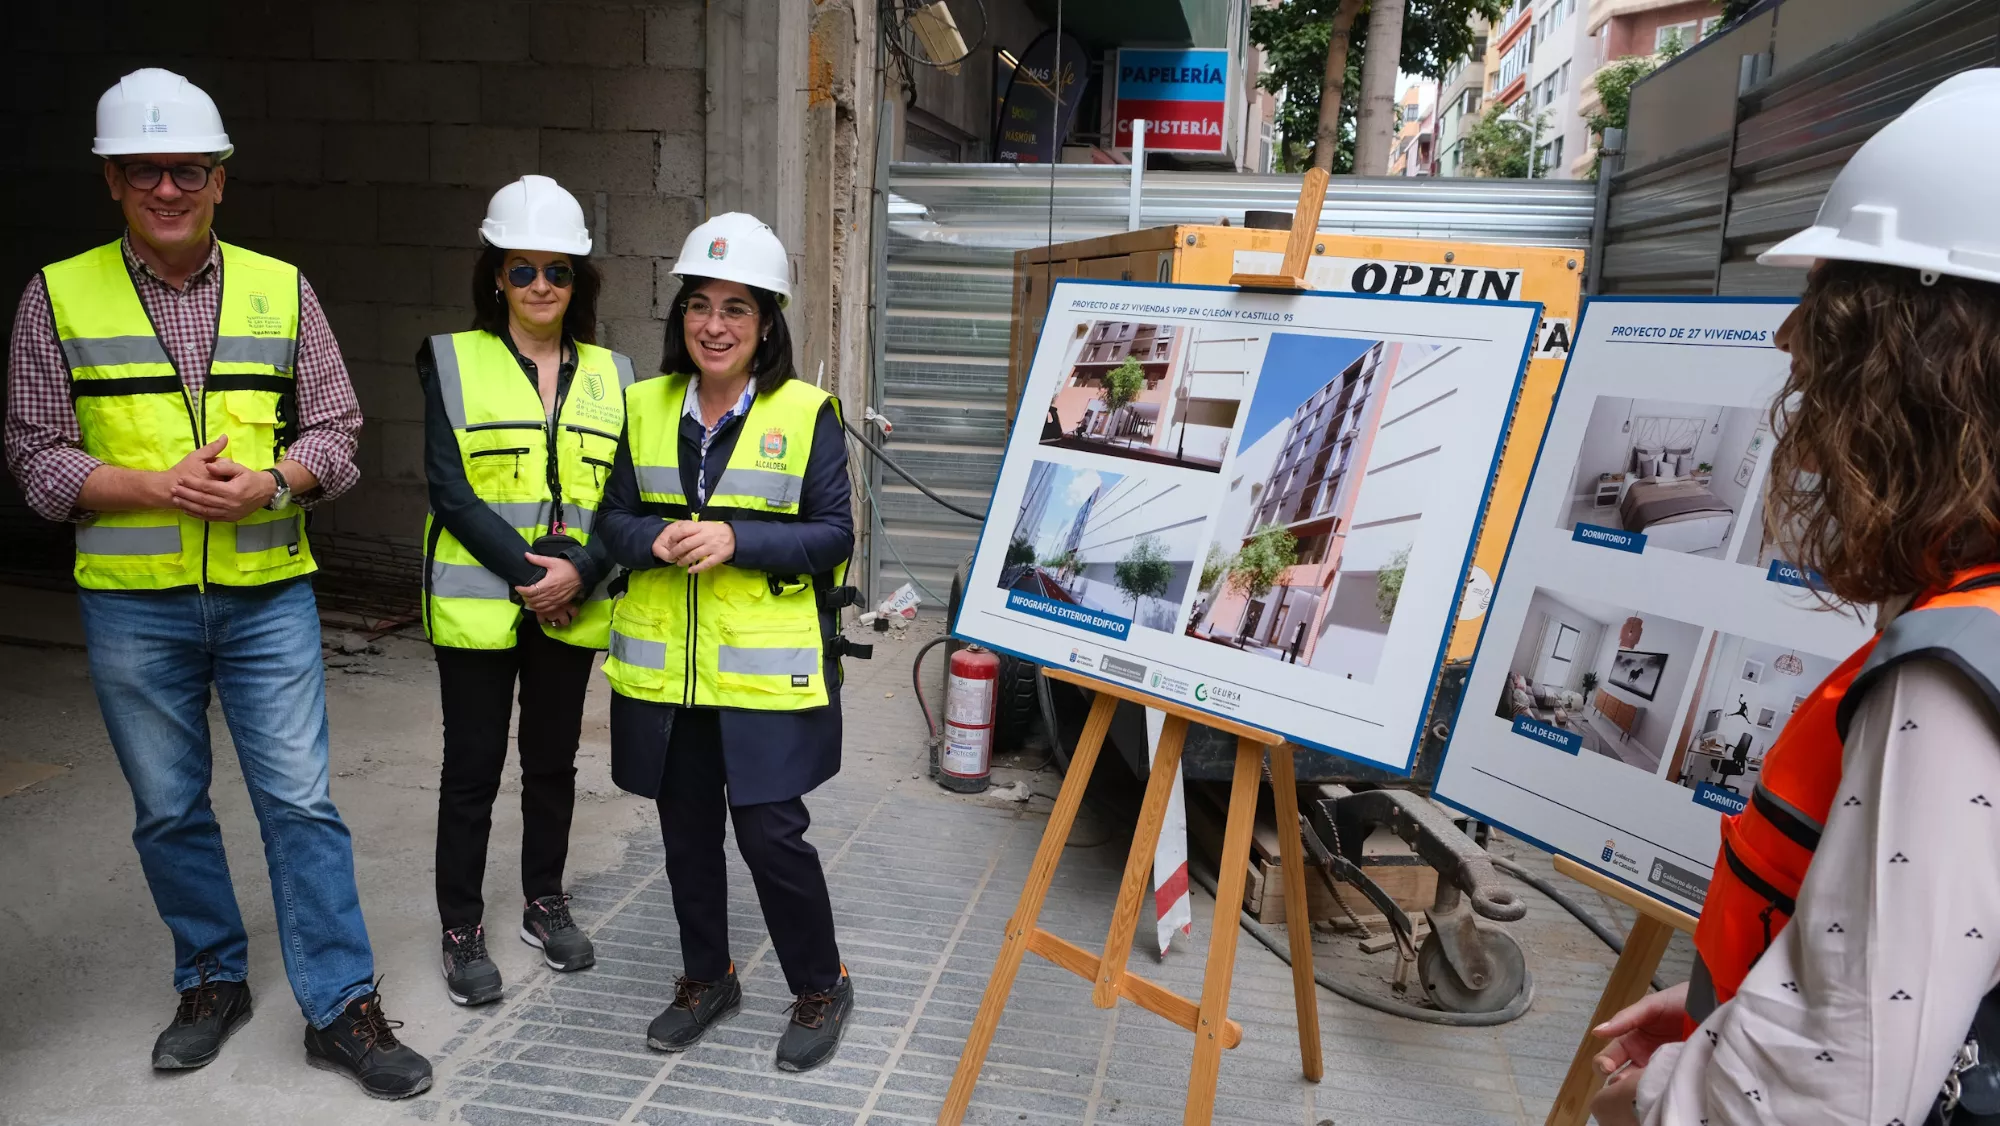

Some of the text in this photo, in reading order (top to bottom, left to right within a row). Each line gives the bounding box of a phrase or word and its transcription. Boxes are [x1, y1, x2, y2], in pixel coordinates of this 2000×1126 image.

[1122, 64, 1224, 84] PAPELERÍA
[1351, 263, 1520, 301] OPEIN
[1072, 300, 1294, 322] PROYECTO DE 27 VIVIENDAS VPP EN C/LEÓN Y CASTILLO, 95
[1612, 326, 1666, 338] PROYECTO
[1669, 327, 1685, 339] DE
[1687, 328, 1701, 339] 27
[1704, 329, 1767, 342] VIVIENDAS
[755, 460, 787, 471] ALCALDESA
[1582, 528, 1632, 546] DORMITORIO 1
[1012, 595, 1125, 633] INFOGRAFÍAS EXTERIOR EDIFICIO
[1212, 686, 1241, 701] GEURSA
[1521, 721, 1569, 745] SALA DE ESTAR
[1614, 851, 1637, 865] Gobierno
[1619, 860, 1639, 875] Canarias
[1662, 872, 1685, 887] Gobierno
